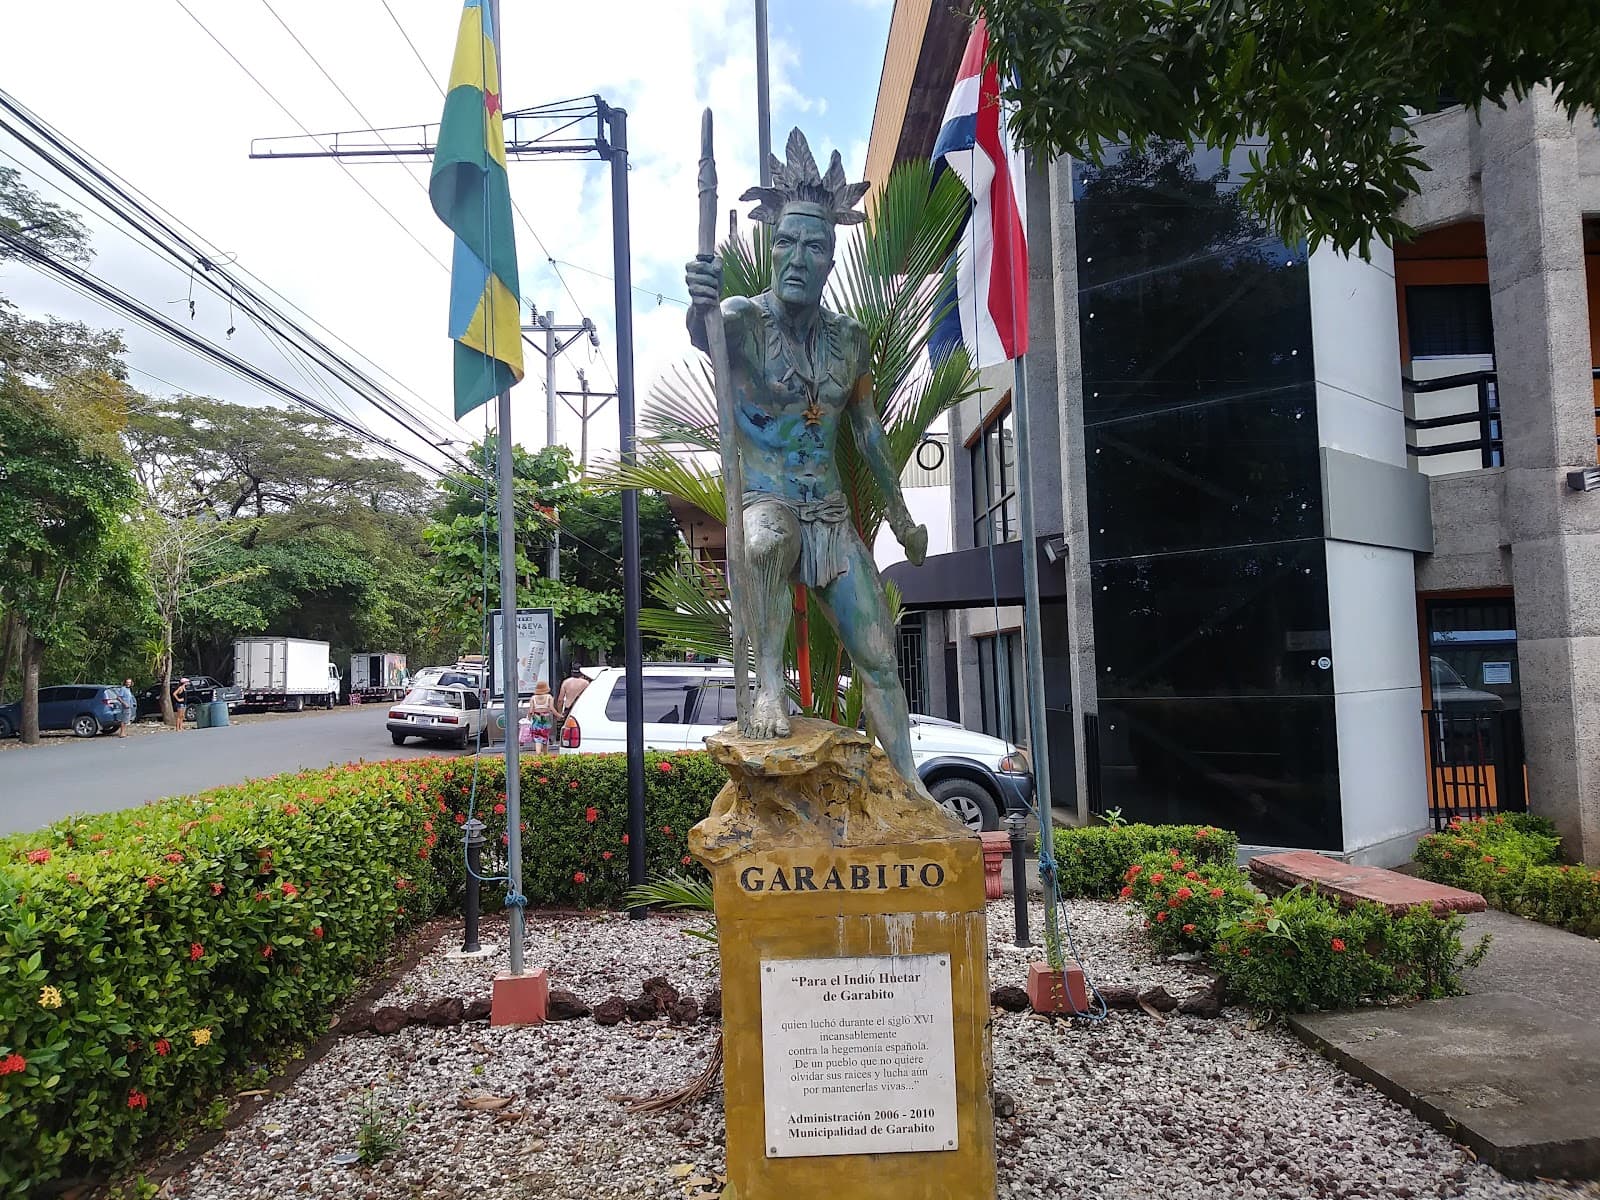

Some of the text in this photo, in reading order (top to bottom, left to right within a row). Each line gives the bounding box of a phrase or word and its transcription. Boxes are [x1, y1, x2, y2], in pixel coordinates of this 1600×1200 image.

[740, 863, 945, 891] GARABITO
[831, 975, 840, 985] el
[844, 974, 875, 985] Indio
[879, 973, 920, 983] Huetar
[823, 989, 894, 1001] de Garabito
[781, 1015, 934, 1032] quien luchó durante el siglo XVI
[820, 1030, 896, 1041] incansablemente
[789, 1046, 817, 1056] contra
[820, 1045, 828, 1054] la
[885, 1042, 928, 1054] española.
[794, 1060, 808, 1069] De
[826, 1058, 858, 1070] pueblo
[860, 1059, 877, 1068] que
[894, 1055, 923, 1065] quiere
[791, 1071, 823, 1081] olvidar
[874, 1071, 880, 1080] y
[883, 1068, 908, 1078] lucha
[803, 1086, 818, 1096] por
[822, 1082, 878, 1094] mantenerlas
[788, 1112, 871, 1124] Administración
[874, 1110, 899, 1120] 2006
[910, 1108, 934, 1119] 2010
[789, 1123, 934, 1139] Municipalidad de Garabito
